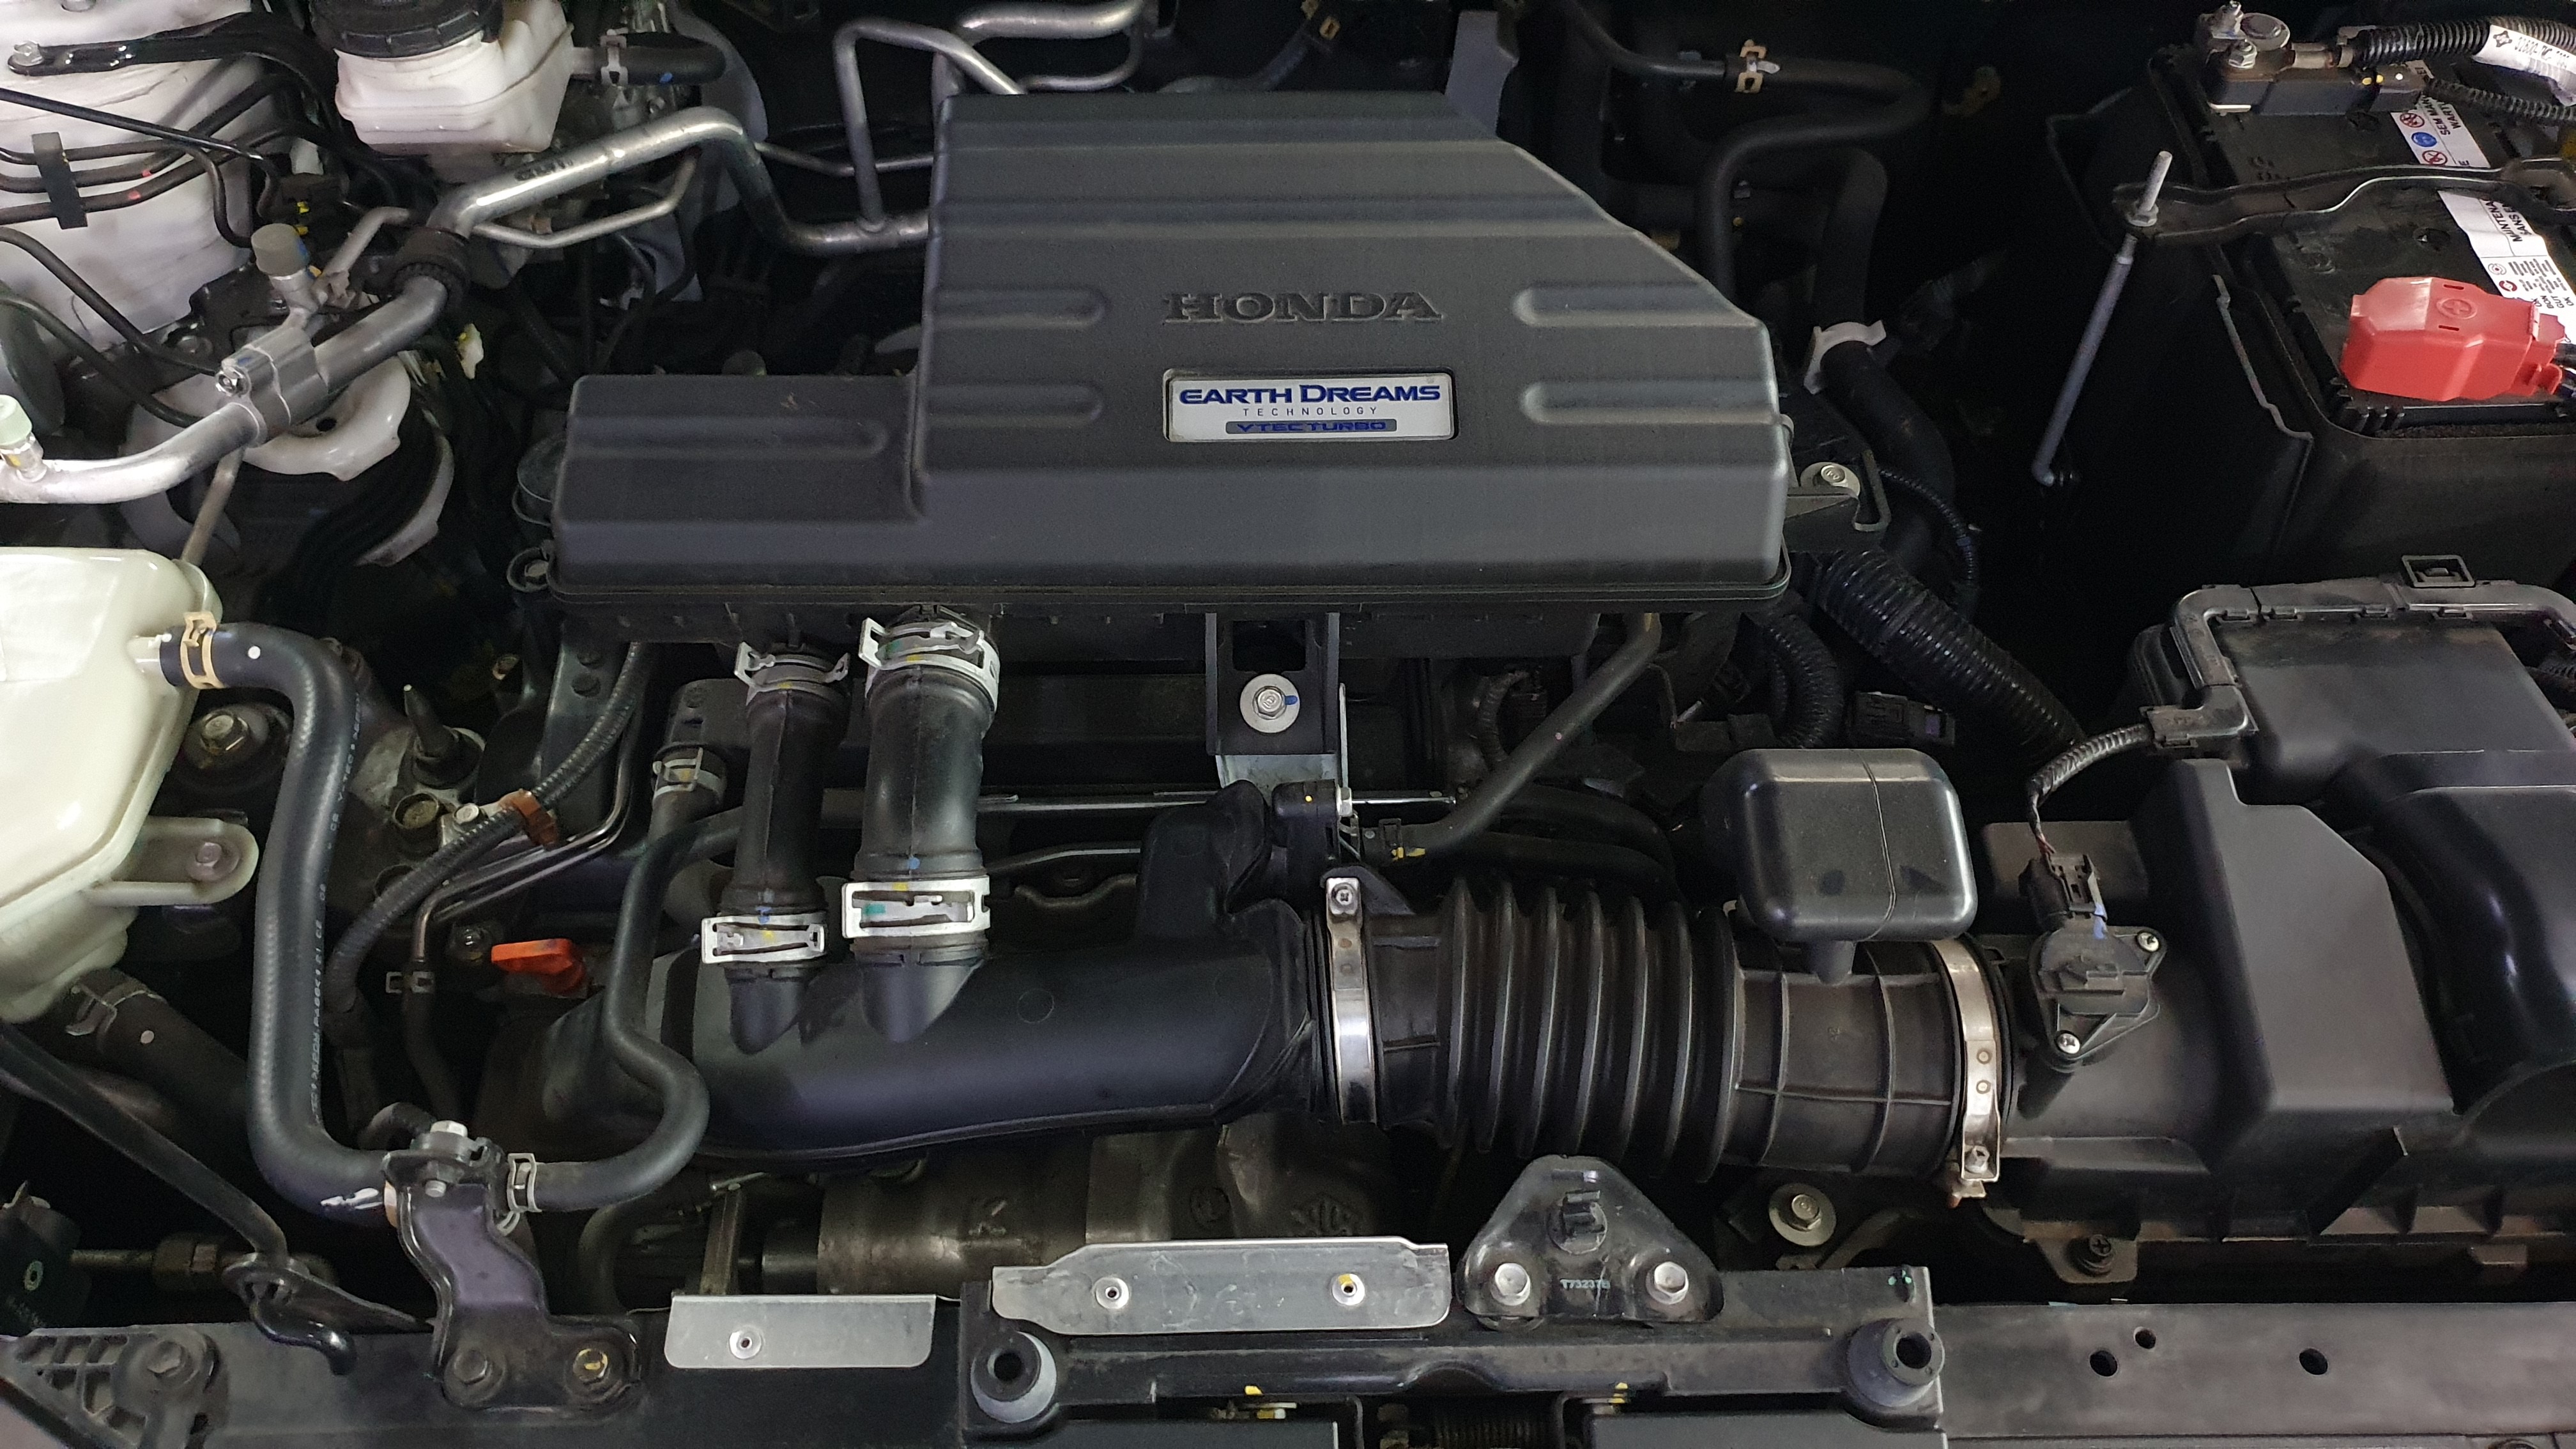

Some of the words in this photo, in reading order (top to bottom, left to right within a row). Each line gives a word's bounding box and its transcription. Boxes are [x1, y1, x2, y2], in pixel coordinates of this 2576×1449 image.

[2420, 96, 2438, 116] MAN
[2440, 103, 2461, 129] WART
[2432, 118, 2451, 135] SEM
[2483, 199, 2523, 242] MAINTENA
[1164, 292, 1443, 323] HONDA
[2540, 295, 2554, 309] BON
[2550, 296, 2564, 308] GUT
[2563, 297, 2574, 306] OK
[1179, 387, 1292, 405] EARTH
[1300, 384, 1441, 403] DREAMS
[1242, 406, 1377, 417] TECHNOLOGY
